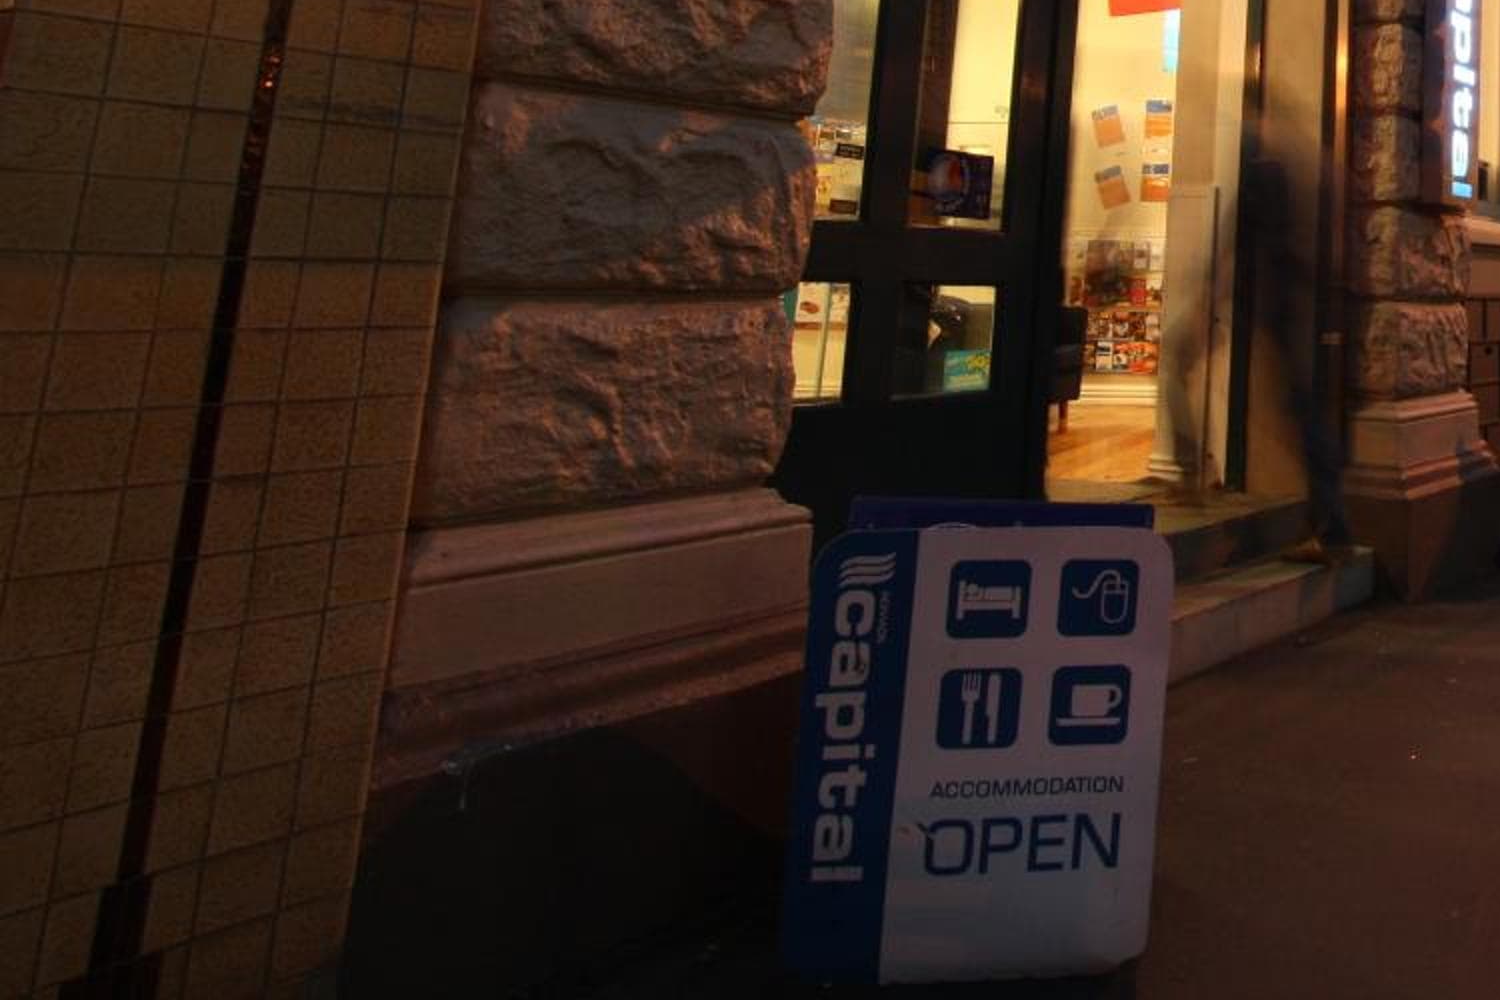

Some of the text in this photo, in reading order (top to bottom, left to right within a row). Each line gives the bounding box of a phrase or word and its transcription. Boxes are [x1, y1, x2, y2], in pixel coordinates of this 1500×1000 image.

[810, 587, 877, 883] capital
[929, 774, 1125, 799] ACCOMMODATION
[922, 811, 1122, 878] OPEN
